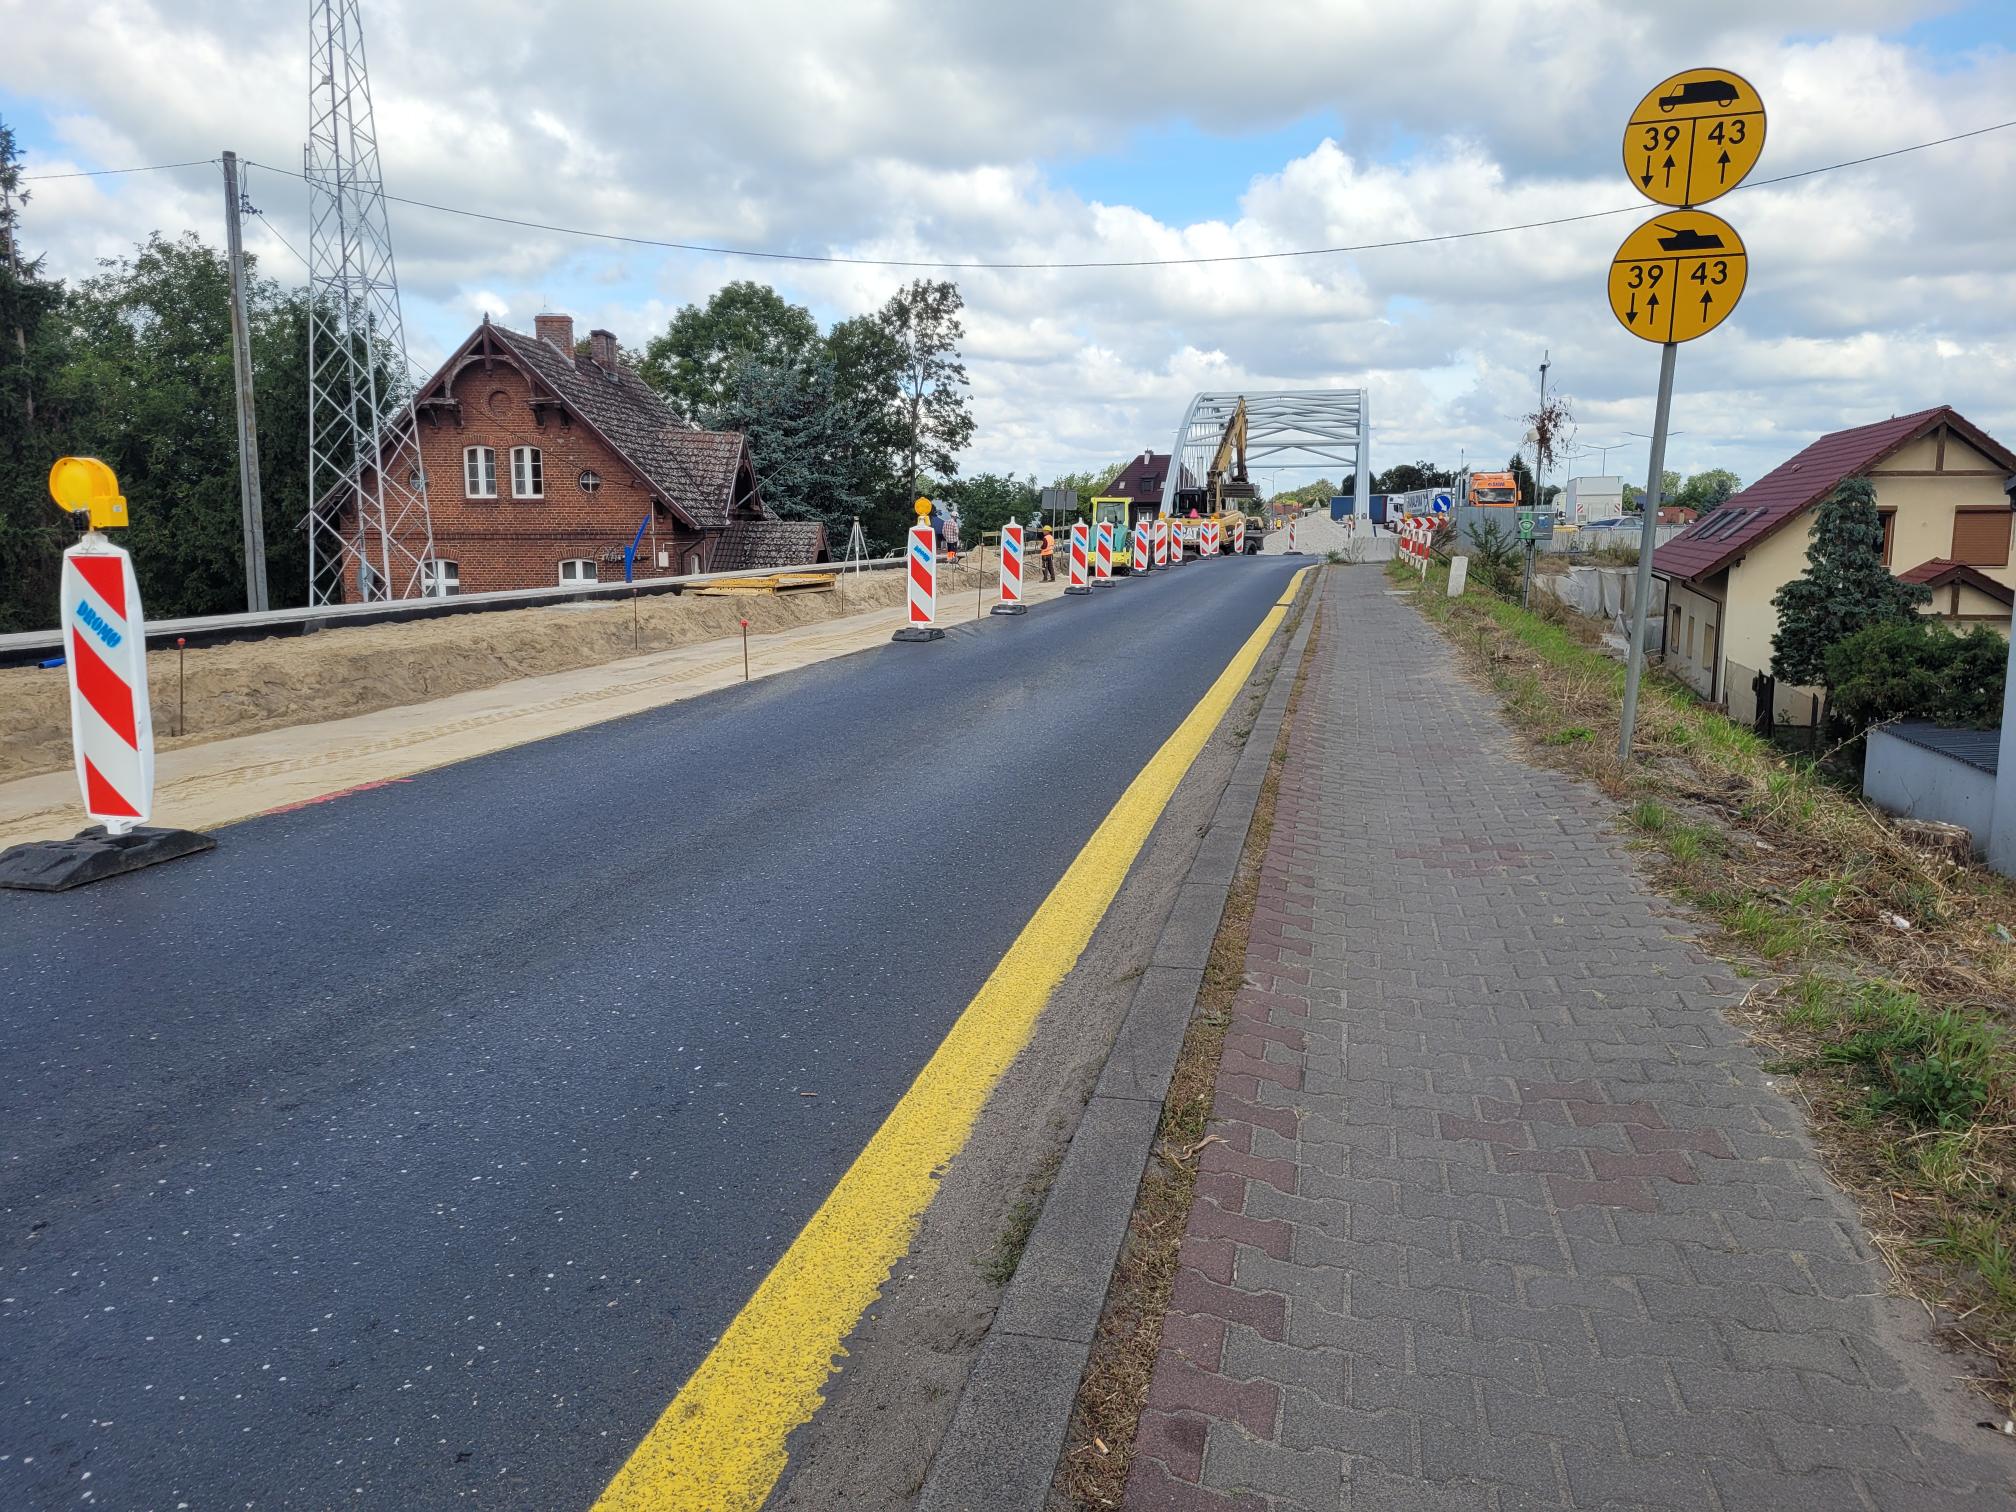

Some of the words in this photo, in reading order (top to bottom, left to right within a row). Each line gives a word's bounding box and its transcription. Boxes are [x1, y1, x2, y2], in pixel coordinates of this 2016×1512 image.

[1642, 125, 1680, 151] 39
[1707, 119, 1746, 145] 43
[1627, 264, 1664, 289] 39
[1690, 260, 1728, 286] 43
